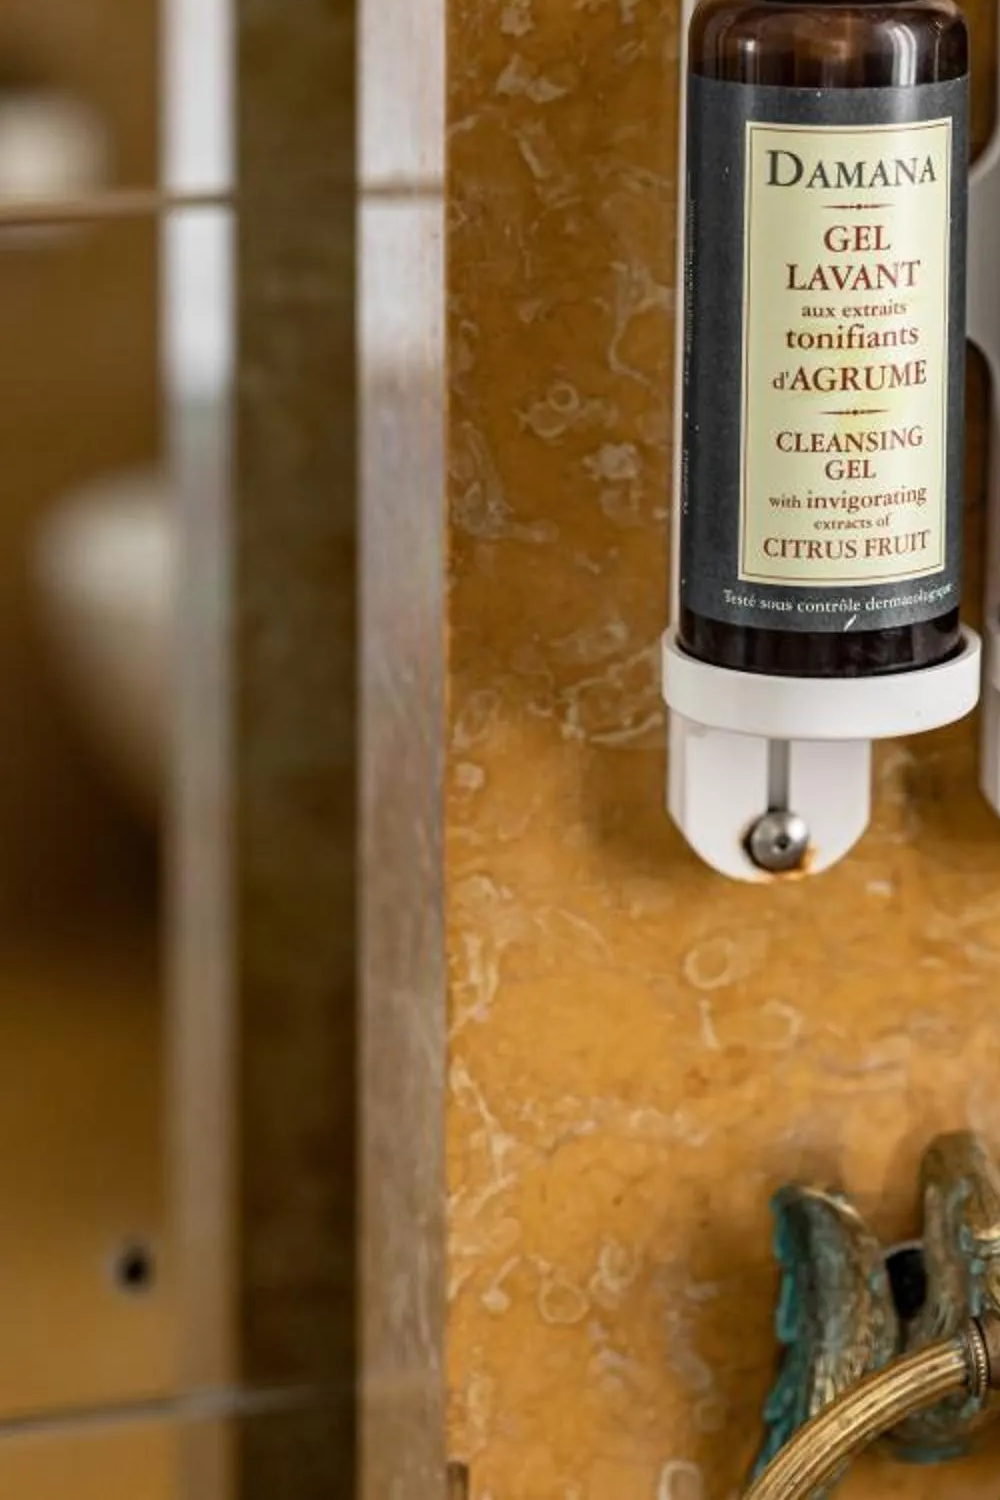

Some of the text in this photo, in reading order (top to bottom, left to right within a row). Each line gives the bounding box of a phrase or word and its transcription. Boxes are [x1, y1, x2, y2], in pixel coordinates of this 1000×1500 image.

[823, 225, 891, 252] GEL
[786, 260, 921, 291] LAVANT
[801, 299, 907, 318] aux extraits
[786, 323, 919, 350] tonifiants
[772, 359, 927, 392] d'AGRUME
[776, 425, 923, 453] CLEANSING
[825, 459, 877, 480] GEL
[769, 485, 928, 513] with invigorating
[813, 512, 892, 531] extracts of
[763, 529, 931, 561] CITRUS FRUIT
[797, 596, 861, 613] contrôle
